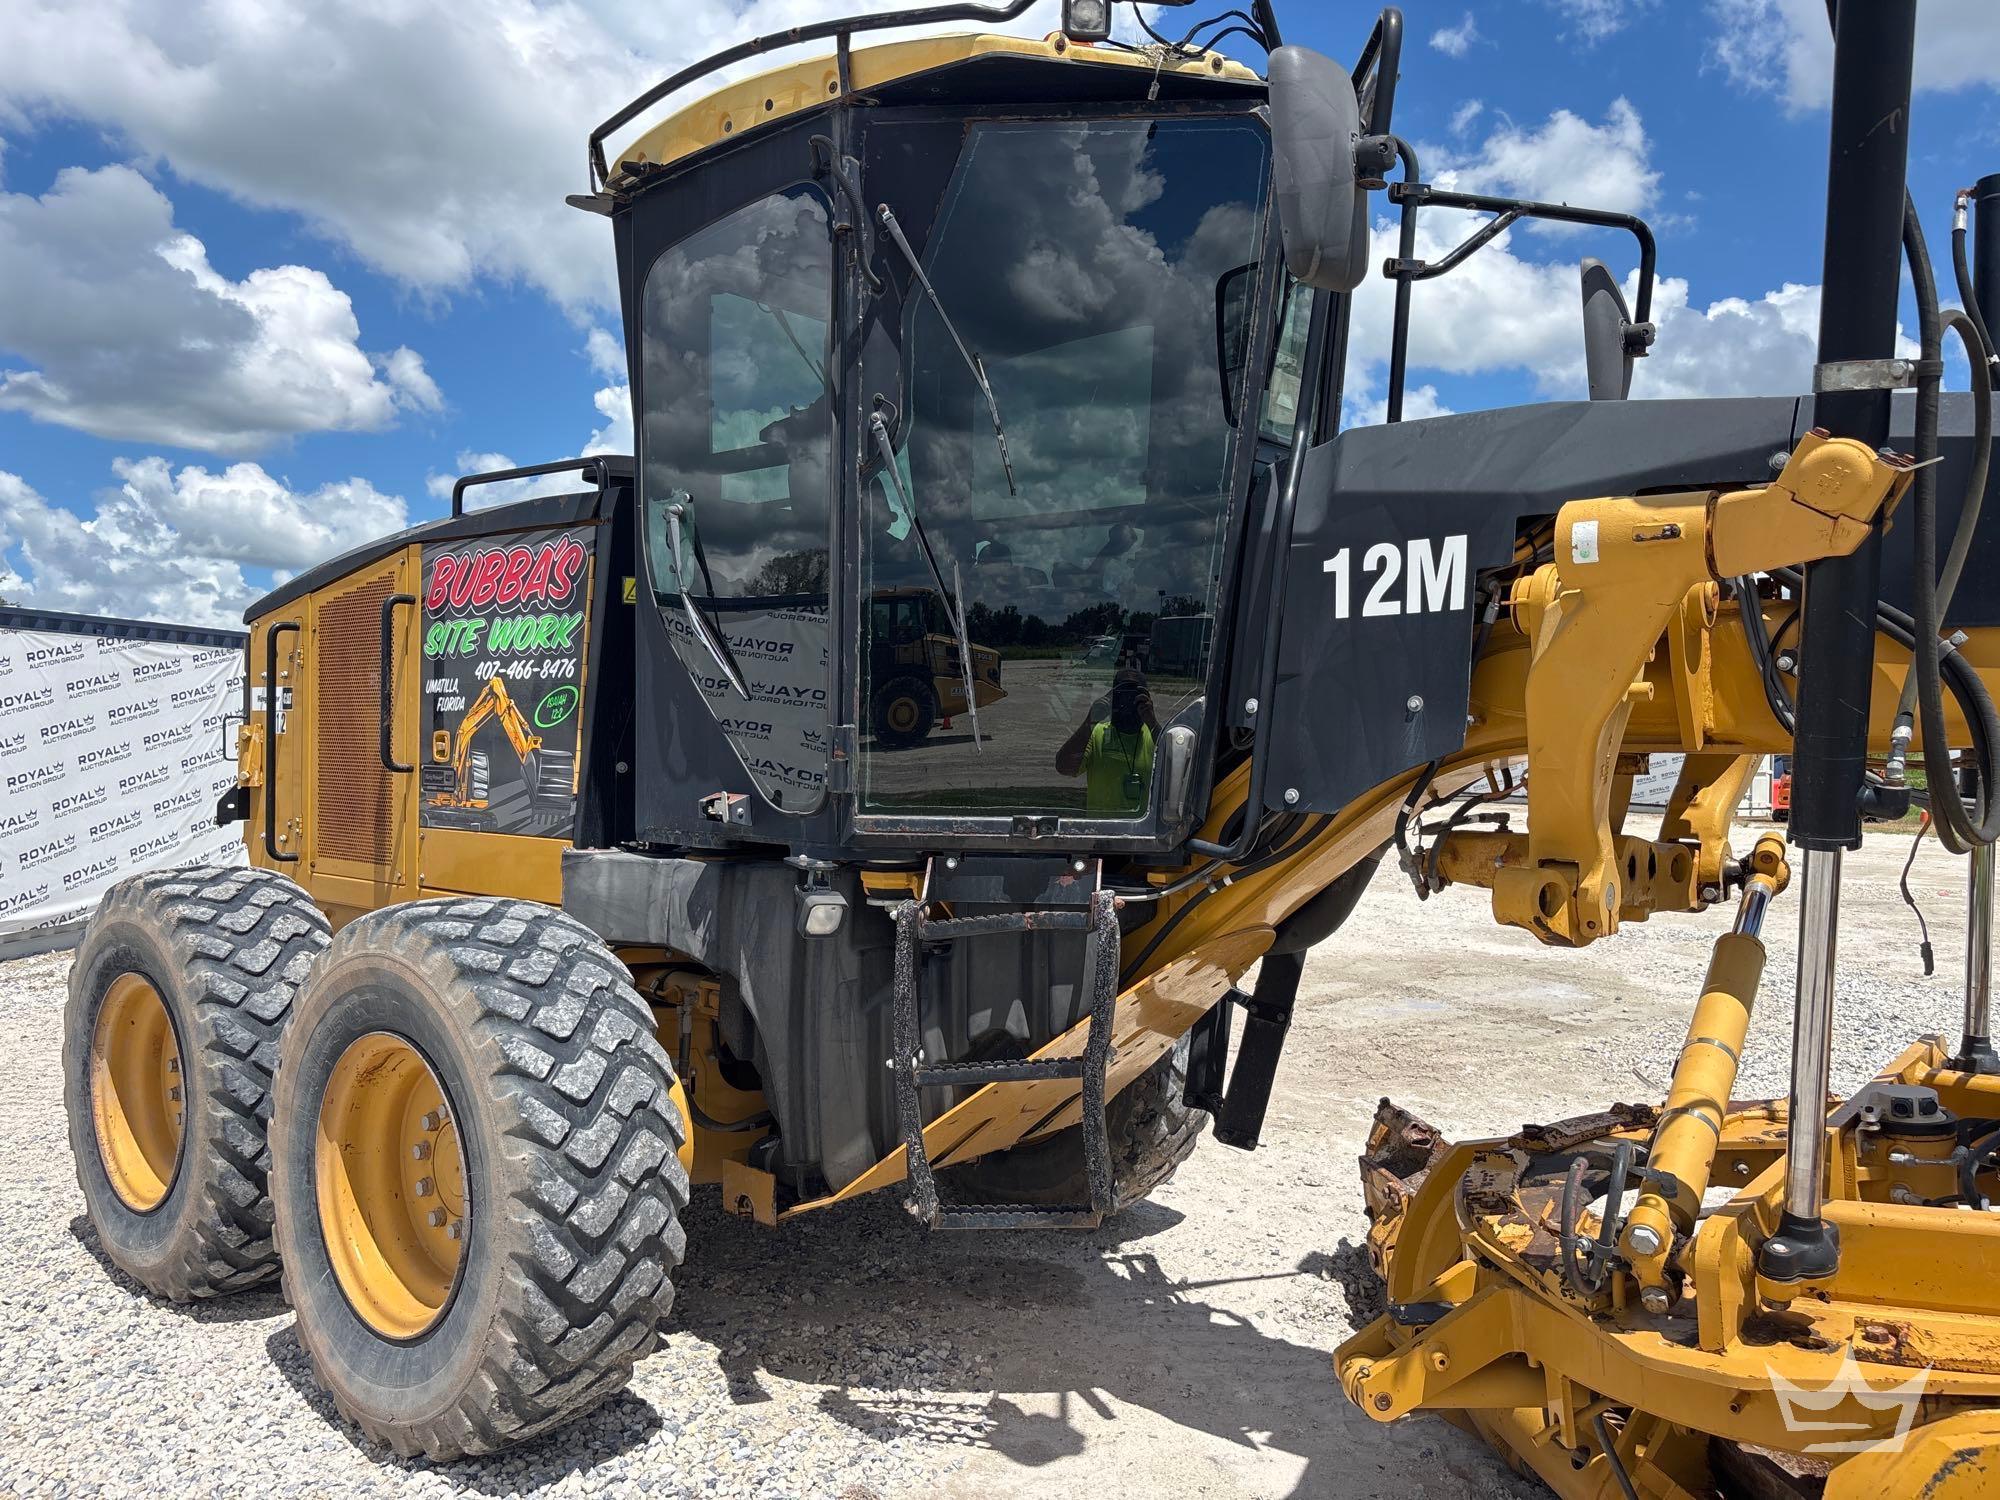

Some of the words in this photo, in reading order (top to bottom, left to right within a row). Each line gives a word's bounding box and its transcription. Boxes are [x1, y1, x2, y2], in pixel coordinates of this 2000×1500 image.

[426, 535, 585, 611] BUBBA'S
[1323, 534, 1468, 619] 12M
[424, 617, 487, 656] SITE
[487, 611, 584, 652] WORK
[27, 646, 72, 662] ROYAL
[99, 646, 127, 655] AUCTION
[192, 648, 227, 663] ROYAL
[29, 658, 60, 669] AUCTION
[61, 654, 84, 663] GROUP
[133, 661, 171, 677] ROYAL
[194, 660, 218, 670] AUCTION
[218, 656, 236, 665] GROUP
[475, 658, 577, 680] 407-466-8476
[66, 675, 109, 692] ROYAL
[134, 673, 162, 684] AUCTION
[162, 668, 182, 677] GROUP
[426, 677, 459, 694] UMATILLA,
[68, 686, 98, 700] AUCTION
[98, 683, 121, 692] GROUP
[171, 687, 207, 702] ROYAL
[173, 698, 198, 709] AUCTION
[199, 693, 217, 703] GROUP
[30, 699, 54, 710] GROUP
[108, 702, 148, 719] ROYAL
[436, 696, 466, 712] FLORIDA
[110, 714, 138, 726] AUCTION
[138, 709, 159, 718] GROUP
[40, 719, 83, 738] ROYAL
[43, 733, 72, 745] AUCTION
[73, 726, 96, 736] GROUP
[143, 728, 182, 745] ROYAL
[1, 746, 27, 757] GROUP
[145, 741, 172, 752] AUCTION
[173, 734, 192, 744] GROUP
[78, 746, 120, 765] ROYAL
[80, 760, 109, 772] AUCTION
[110, 752, 132, 762] GROUP
[181, 751, 217, 768] ROYAL
[7, 766, 53, 787] ROYAL
[183, 764, 208, 775] AUCTION
[9, 780, 42, 795] AUCTION
[43, 773, 65, 784] GROUP
[119, 770, 158, 789] ROYAL
[121, 784, 148, 796] AUCTION
[149, 775, 170, 786] GROUP
[52, 791, 94, 812] ROYAL
[54, 805, 84, 819] AUCTION
[85, 797, 107, 809] GROUP
[154, 793, 192, 812] ROYAL
[155, 807, 182, 819] AUCTION
[183, 798, 202, 810] GROUP
[14, 821, 40, 834] GROUP
[90, 815, 131, 836] ROYAL
[92, 829, 120, 843] AUCTION
[121, 821, 142, 832] GROUP
[192, 828, 216, 839] AUCTION
[19, 840, 64, 863] ROYAL
[130, 836, 169, 857] ROYAL
[132, 850, 159, 864] AUCTION
[160, 841, 180, 852] GROUP
[21, 856, 53, 871] AUCTION
[54, 846, 77, 858] GROUP
[63, 861, 106, 885] ROYAL
[65, 876, 94, 892] AUCTION
[95, 866, 118, 879] GROUP
[0, 890, 37, 911] OYAL
[0, 906, 24, 919] CTION
[25, 894, 50, 908] GROUP
